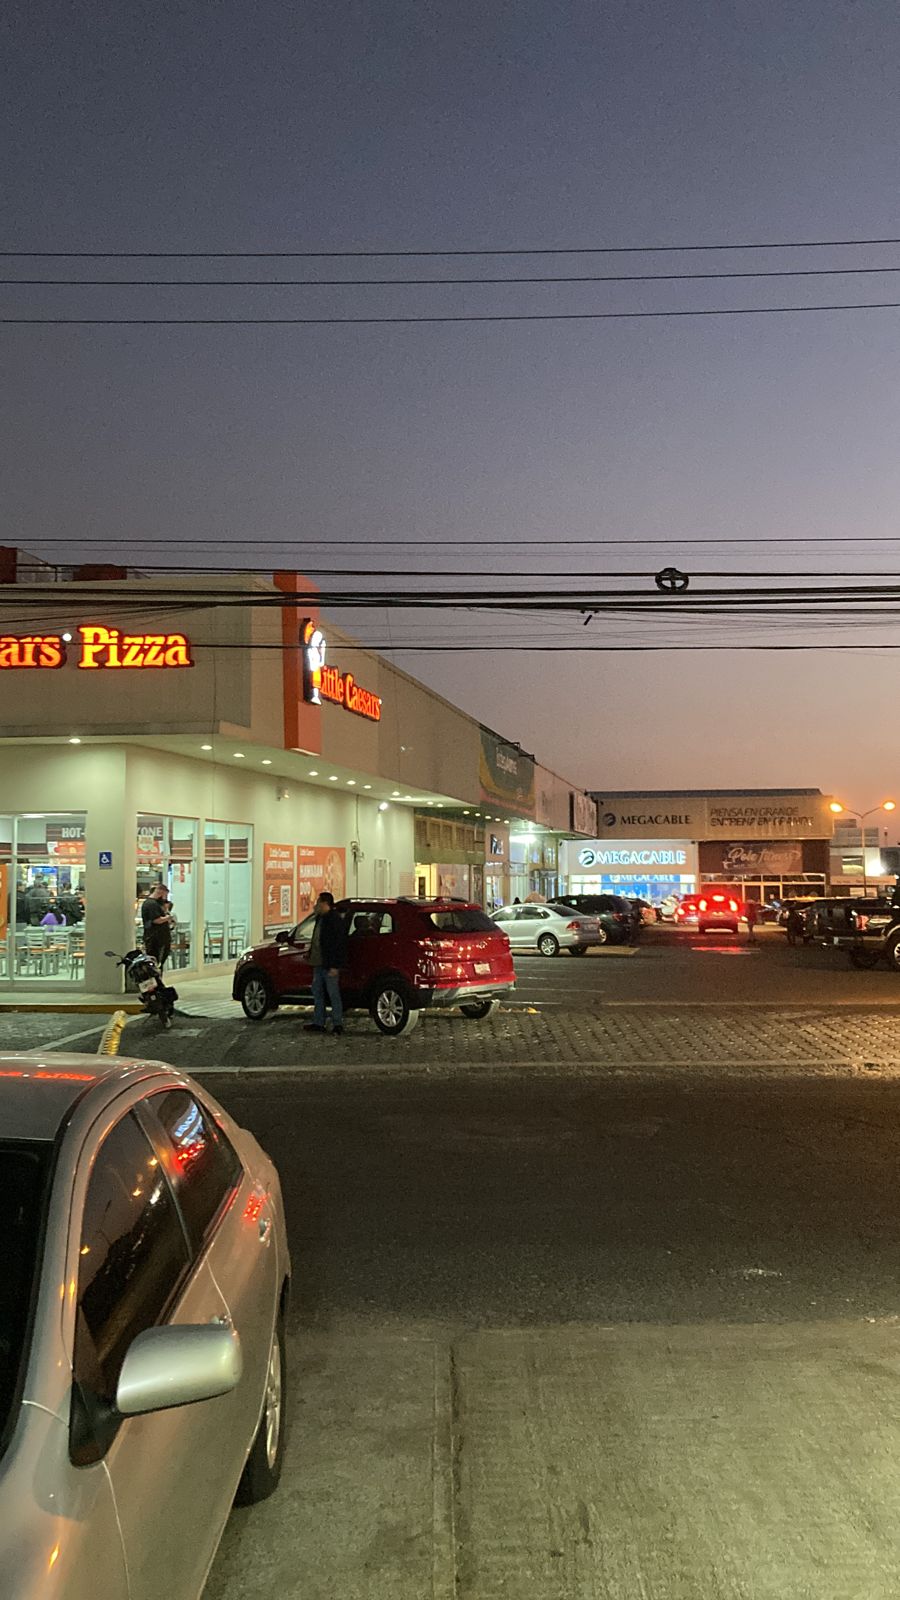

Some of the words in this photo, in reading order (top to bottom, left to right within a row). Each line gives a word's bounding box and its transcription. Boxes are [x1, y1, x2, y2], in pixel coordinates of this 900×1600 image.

[77, 624, 194, 669] Pizza
[343, 672, 381, 722] Caesars
[620, 814, 691, 825] MEGACABLE
[595, 850, 686, 865] MEGACABLE
